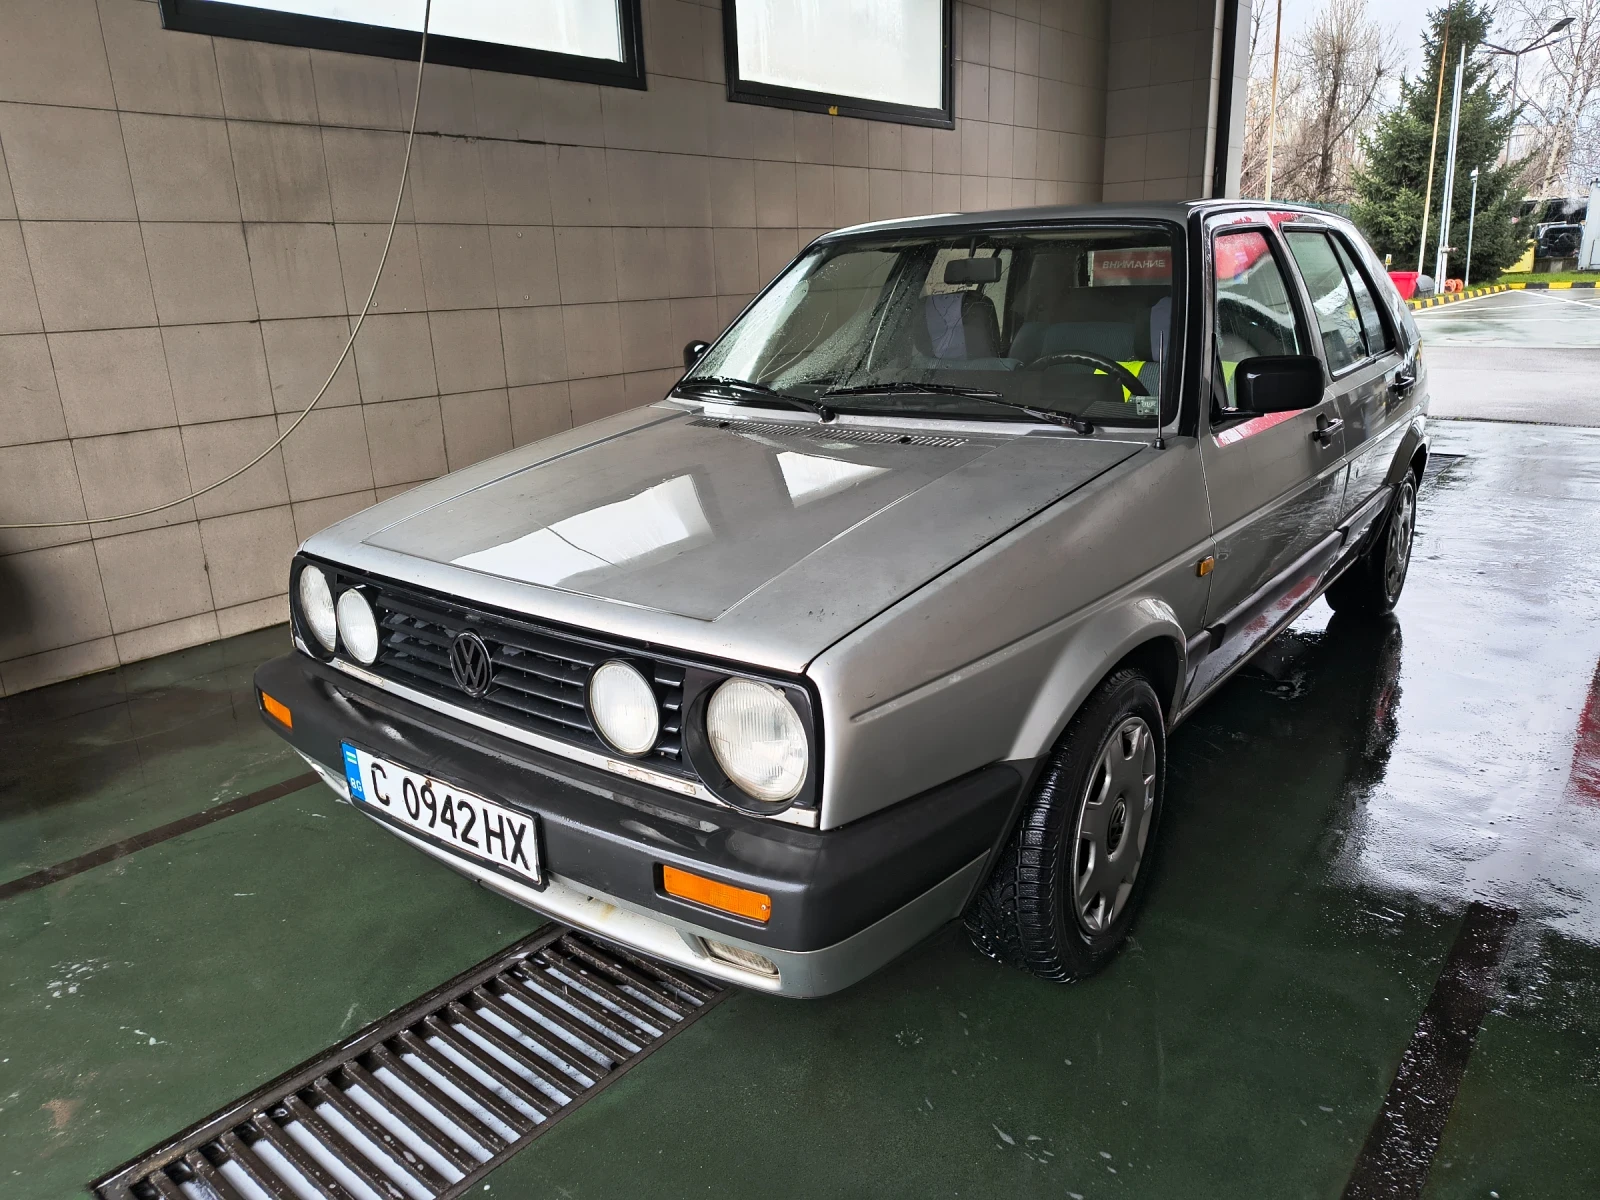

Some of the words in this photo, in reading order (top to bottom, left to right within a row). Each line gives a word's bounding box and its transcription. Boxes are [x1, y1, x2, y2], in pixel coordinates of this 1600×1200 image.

[1102, 259, 1166, 269] ВНИМАНИЕ
[350, 777, 362, 792] BG
[370, 762, 391, 806] C
